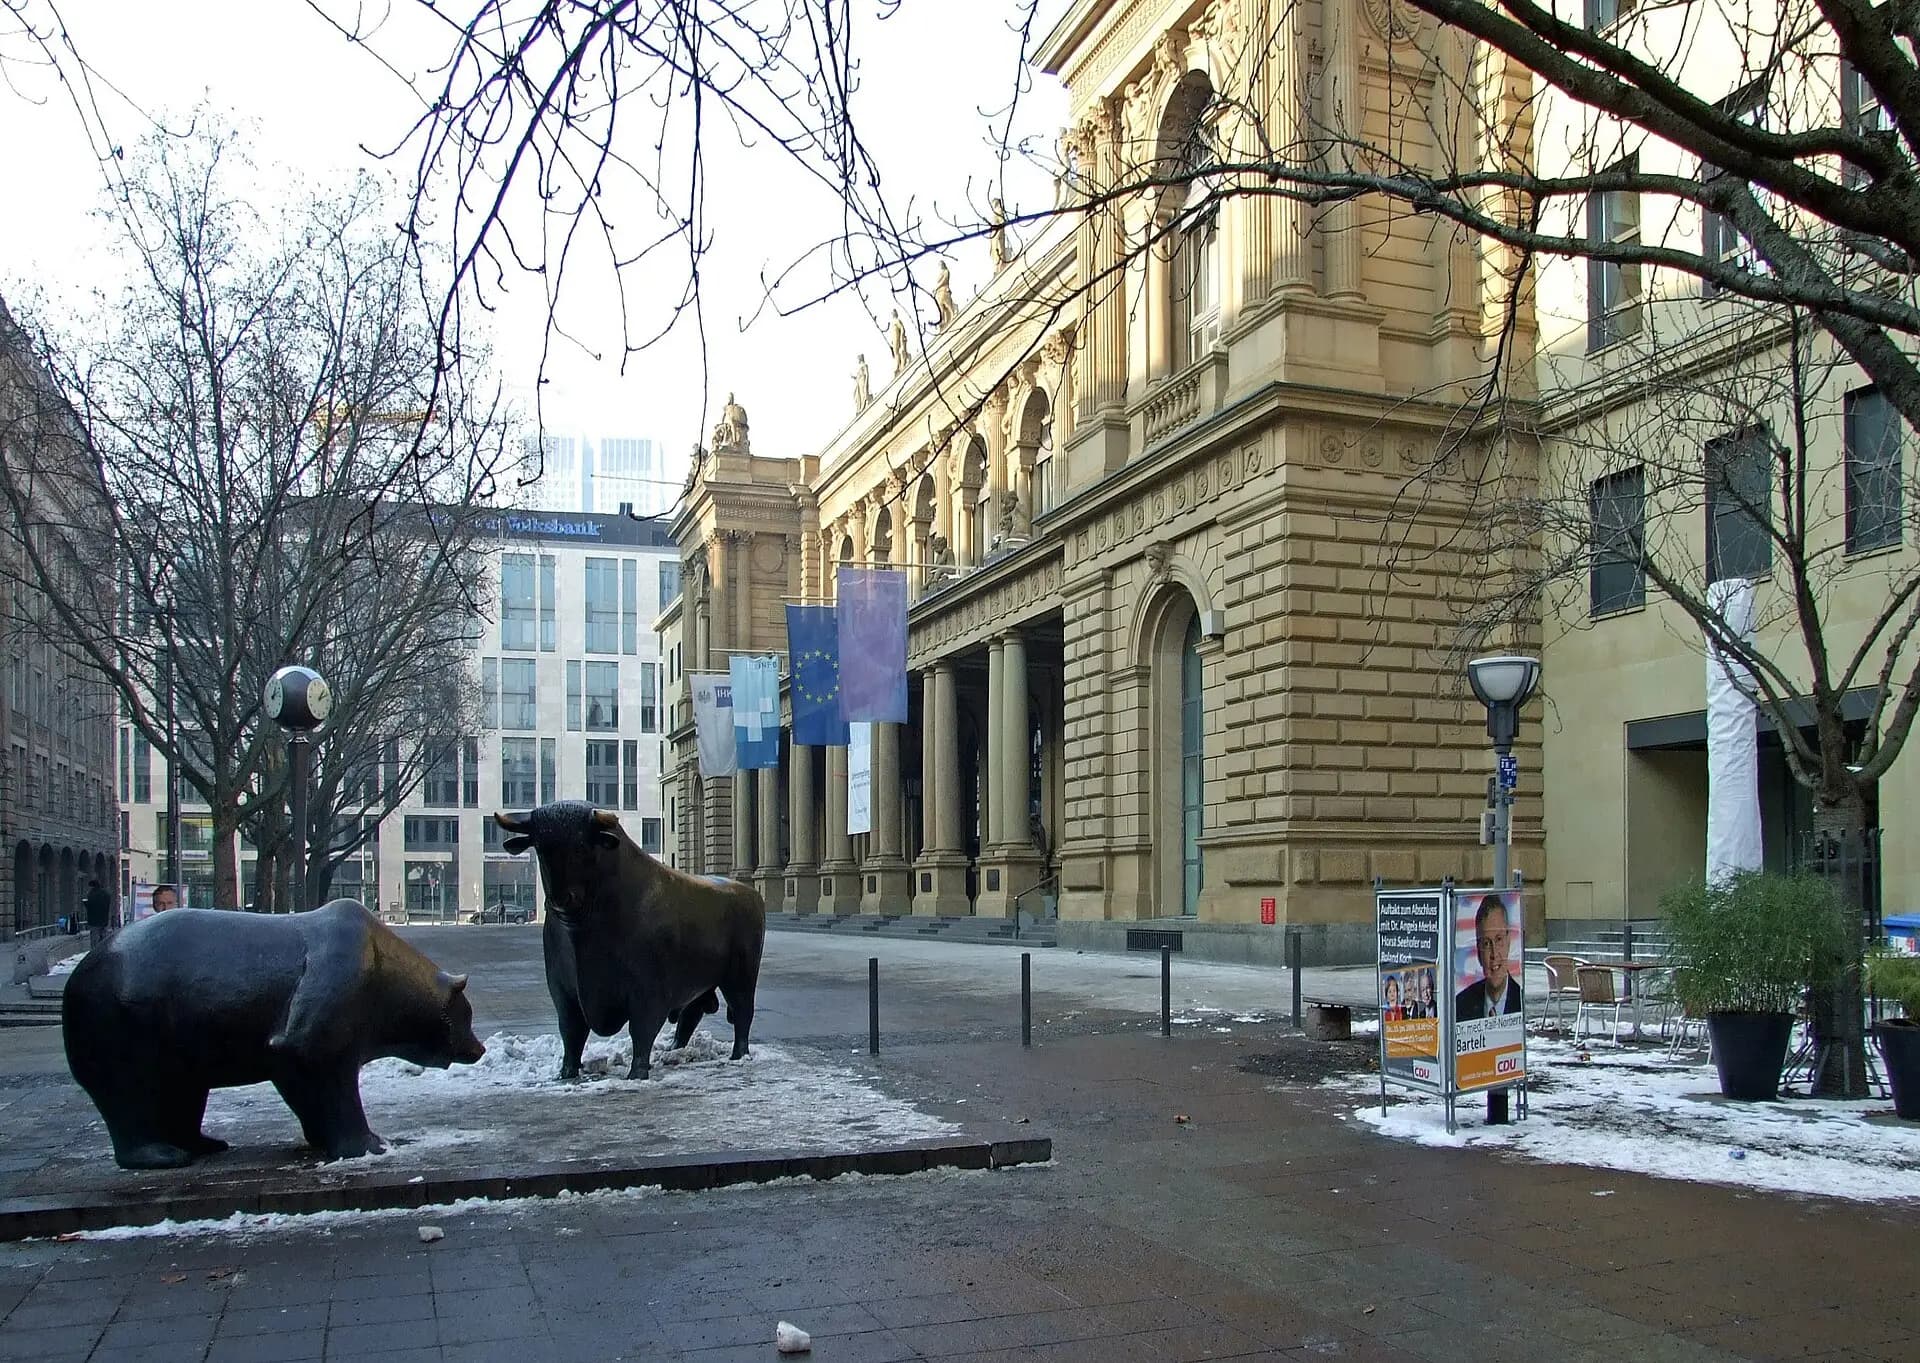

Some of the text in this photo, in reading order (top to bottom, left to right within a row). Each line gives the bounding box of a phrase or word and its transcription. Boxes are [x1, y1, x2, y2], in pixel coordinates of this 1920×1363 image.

[507, 515, 601, 536] Volksbank
[1380, 903, 1438, 916] Auftakt zum Abschluss
[1380, 920, 1390, 931] mit
[1400, 920, 1418, 934] Angela
[1381, 936, 1432, 949] Horst Seehofer und
[1381, 951, 1399, 964] Roland
[1456, 1034, 1486, 1053] Bartelt
[1497, 1058, 1517, 1073] CDU
[1414, 1067, 1430, 1079] CDU
